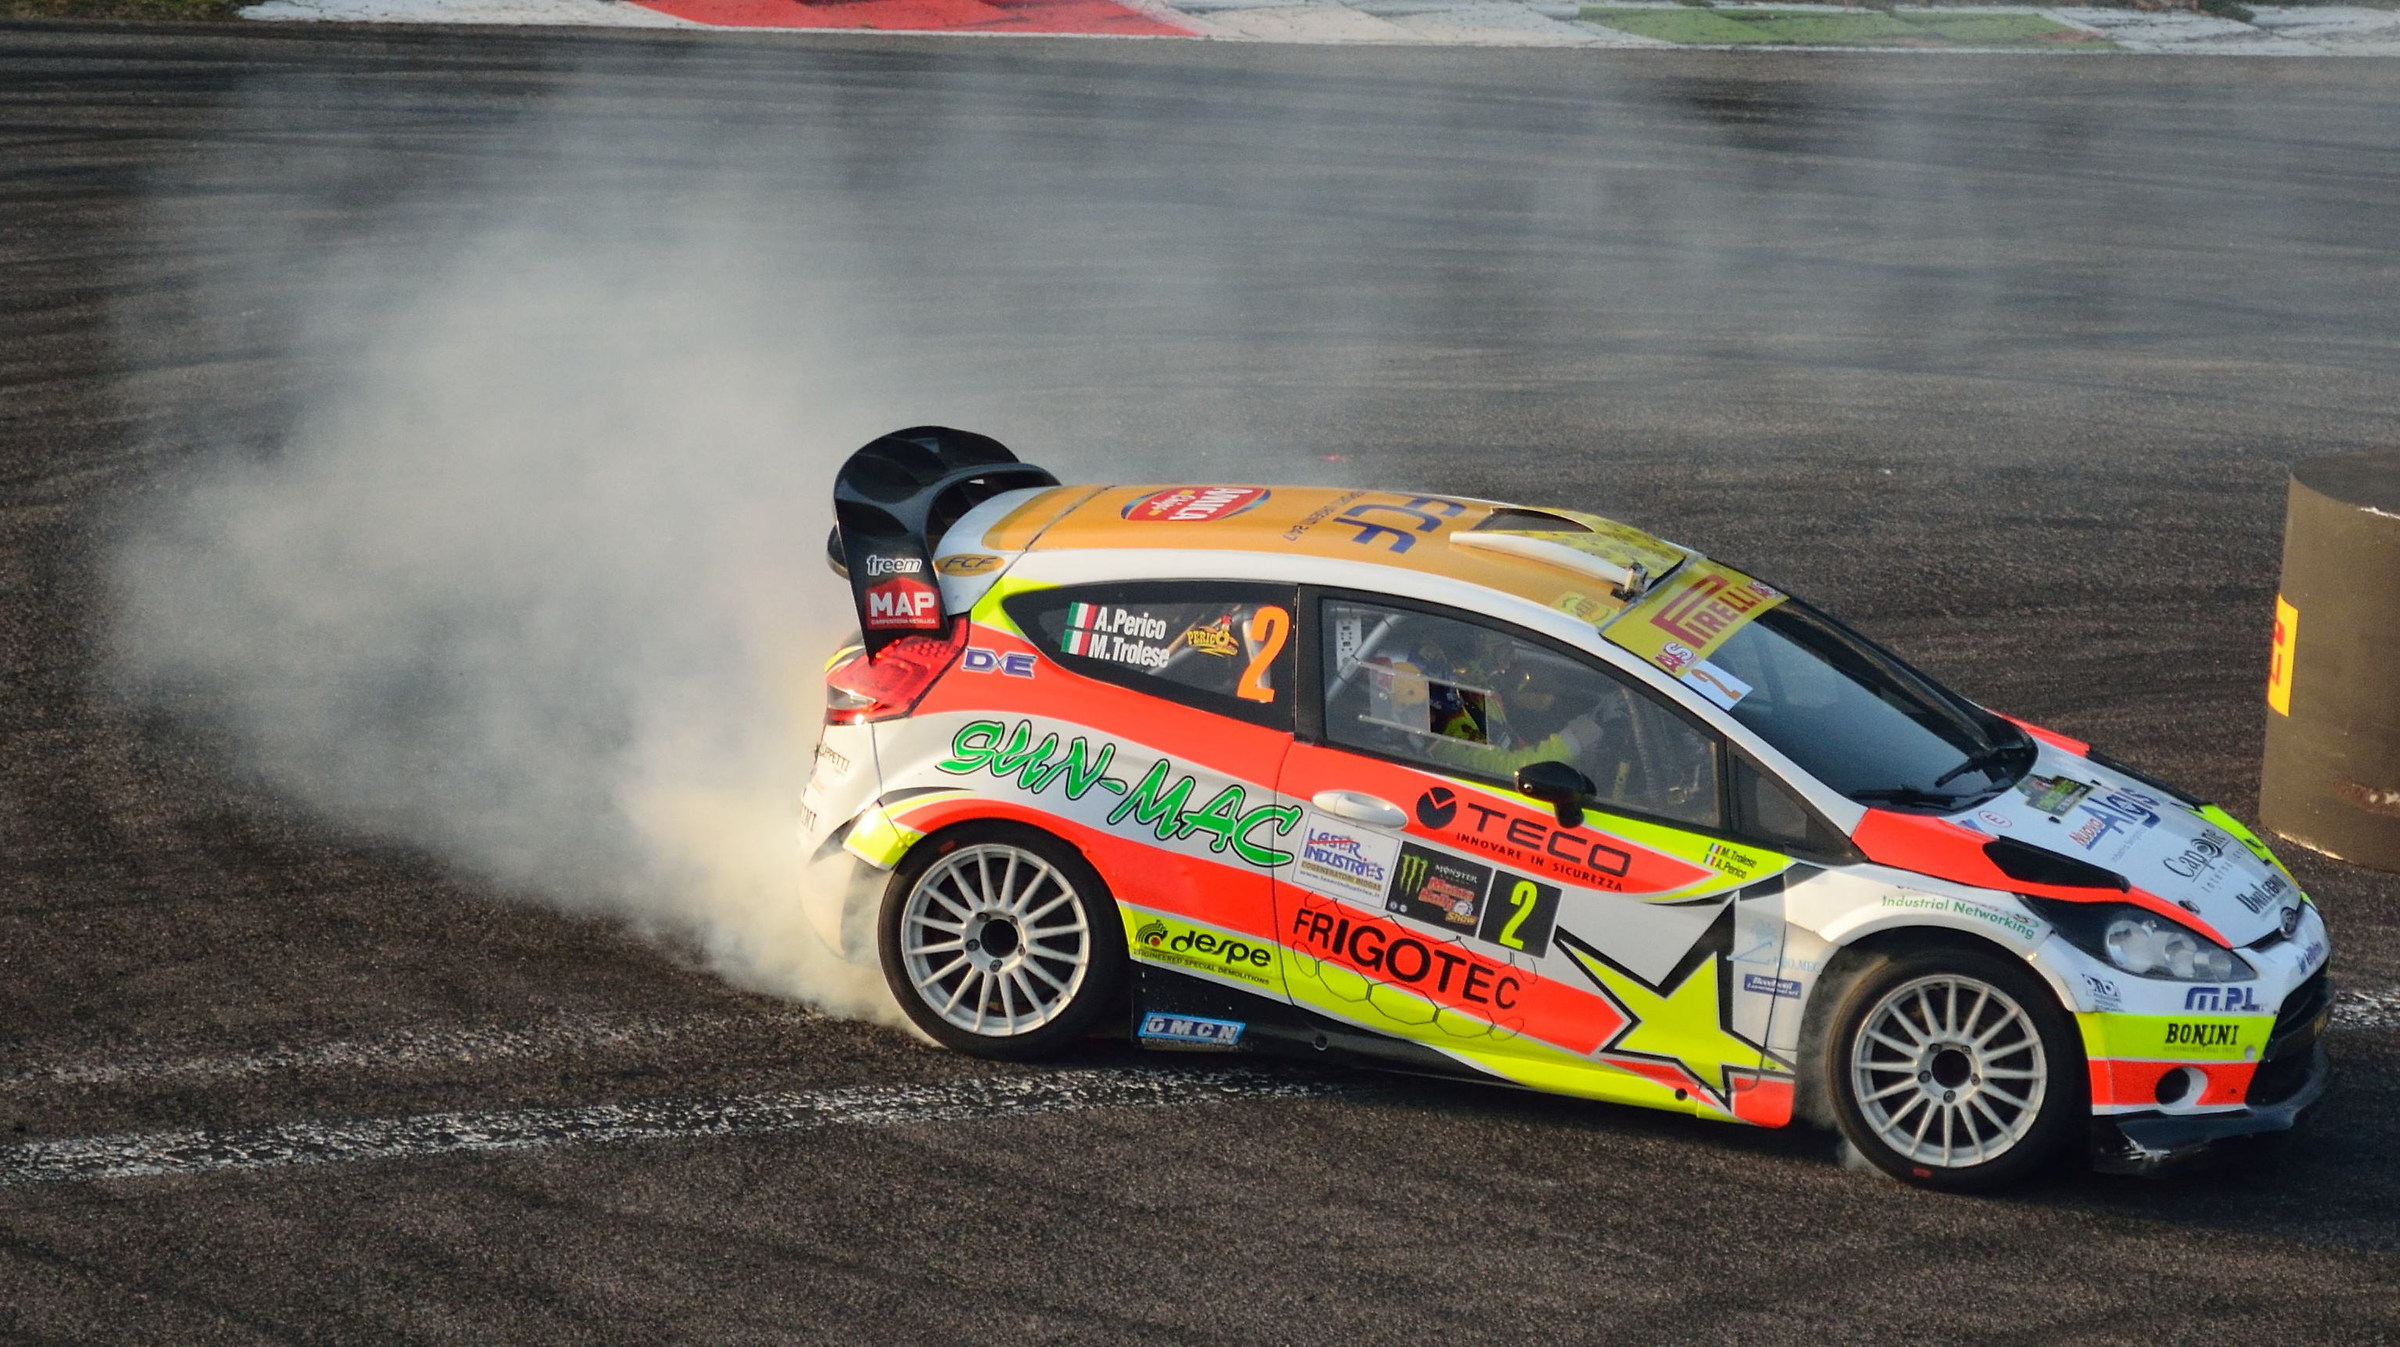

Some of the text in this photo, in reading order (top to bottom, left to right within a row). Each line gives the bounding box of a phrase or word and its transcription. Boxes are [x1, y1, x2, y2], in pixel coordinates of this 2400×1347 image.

[1333, 494, 1467, 554] FCF
[867, 555, 922, 576] freem
[944, 556, 998, 568] FCF
[870, 592, 935, 617] MAP
[1095, 606, 1167, 640] A.Perico
[1650, 573, 1763, 650] PIRELLI
[1088, 633, 1170, 668] M.Trolese
[1236, 605, 1290, 702] 2
[1690, 669, 1742, 700] 2
[936, 719, 1302, 868] SUN-MAC
[1467, 803, 1632, 878] TECO
[1435, 864, 1478, 884] MONSTER
[1456, 833, 1623, 892] INNOVARE IN SICUREZZA
[1499, 880, 1538, 950] 2
[1882, 895, 1949, 911] Industrial
[1953, 901, 2035, 940] Networking
[1170, 930, 1271, 967] despe
[1292, 908, 1521, 1010] FRIGOTEC
[1184, 958, 1215, 972] SPECIAL
[1218, 967, 1270, 985] DEMOLITIONS
[2165, 1023, 2239, 1045] BONINI
